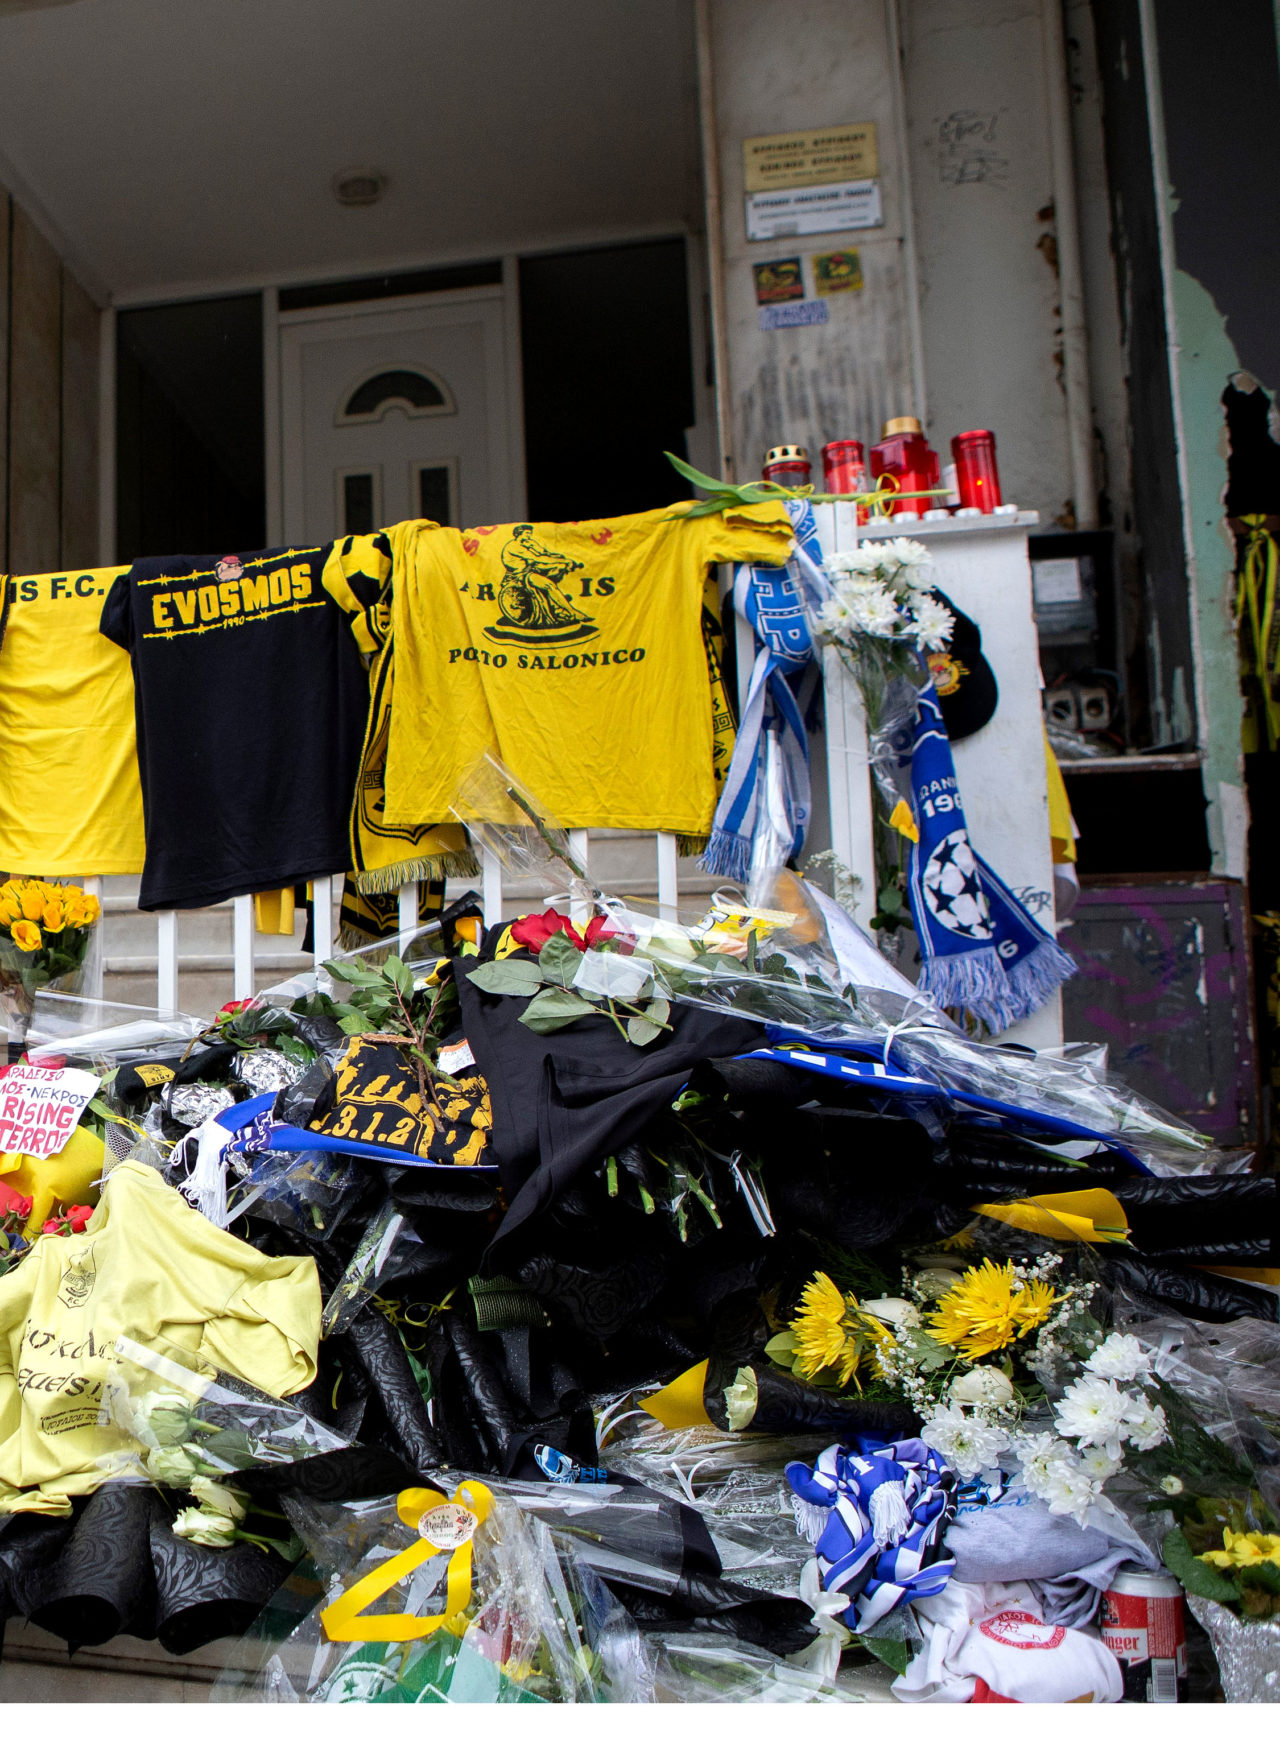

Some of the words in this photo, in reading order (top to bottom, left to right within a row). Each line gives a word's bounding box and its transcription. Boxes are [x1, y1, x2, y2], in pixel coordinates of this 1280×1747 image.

[51, 575, 105, 600] F.C.
[152, 563, 312, 629] EVOSMOS
[222, 615, 246, 630] 1990
[449, 646, 508, 669] POTO
[517, 648, 646, 670] SALONICO
[2, 1095, 75, 1129] RISING
[1102, 1631, 1140, 1655] inger
